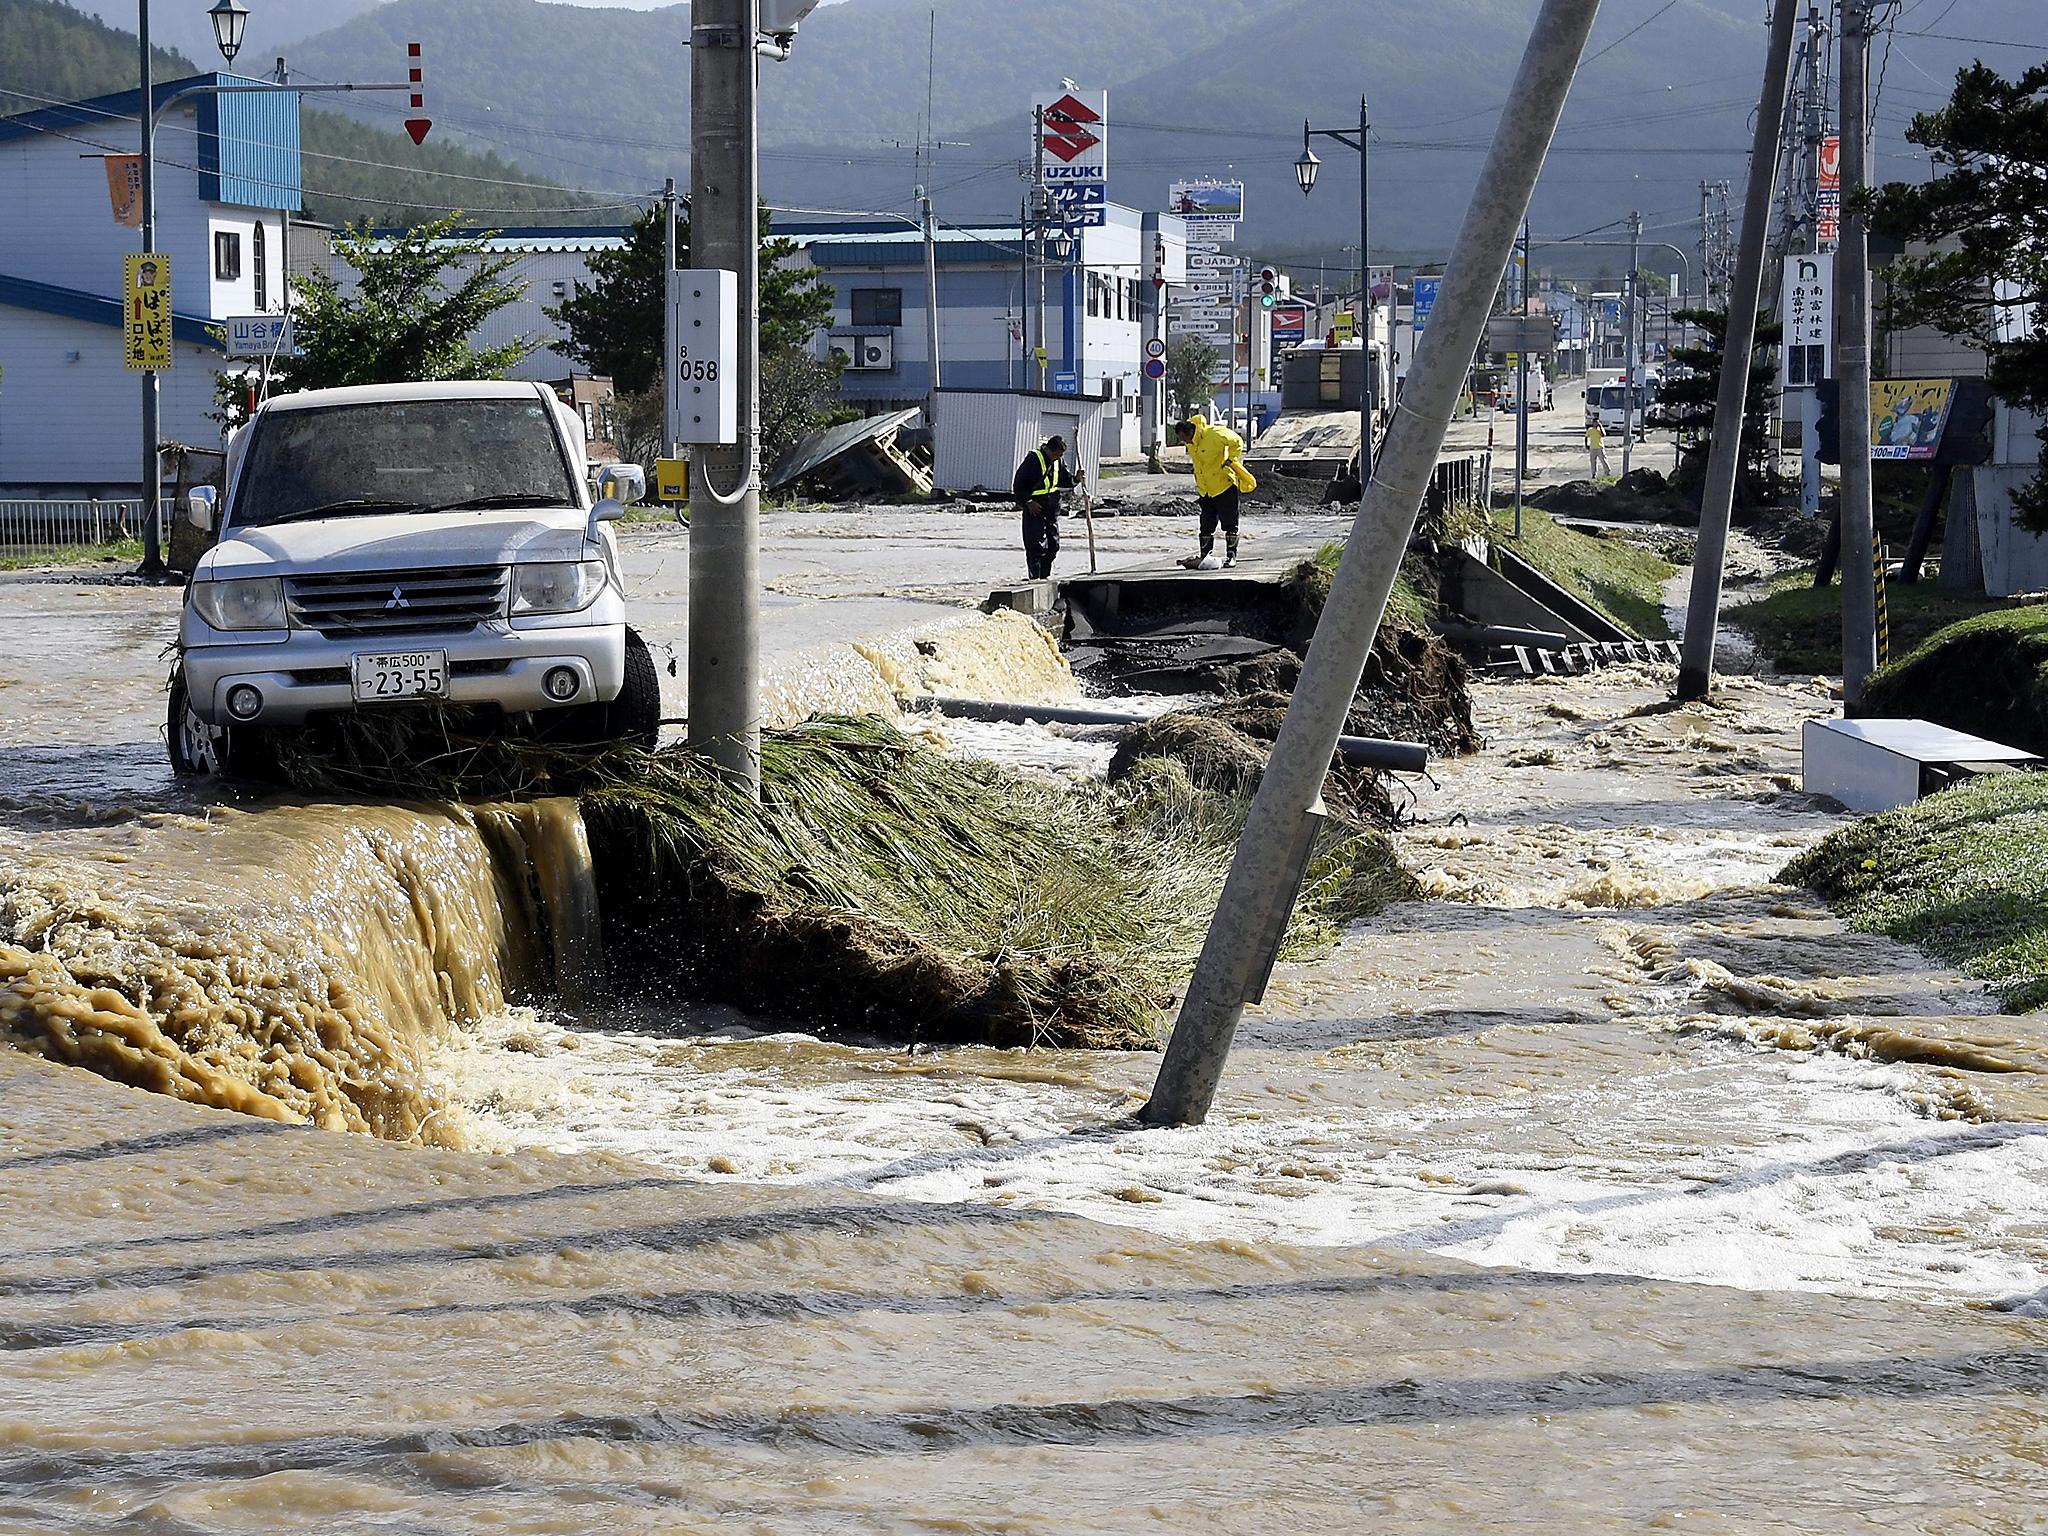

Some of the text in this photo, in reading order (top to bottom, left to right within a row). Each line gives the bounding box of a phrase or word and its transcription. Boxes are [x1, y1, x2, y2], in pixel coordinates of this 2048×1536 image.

[1043, 166, 1103, 178] UZUKI
[143, 289, 167, 352] ぽっぽや
[234, 321, 286, 339] 山谷橋
[132, 323, 145, 361] ロケ地
[234, 341, 261, 350] Yamaya
[1150, 343, 1161, 352] 40
[680, 345, 688, 359] 8
[680, 360, 718, 381] 058
[375, 668, 442, 695] 23-55
